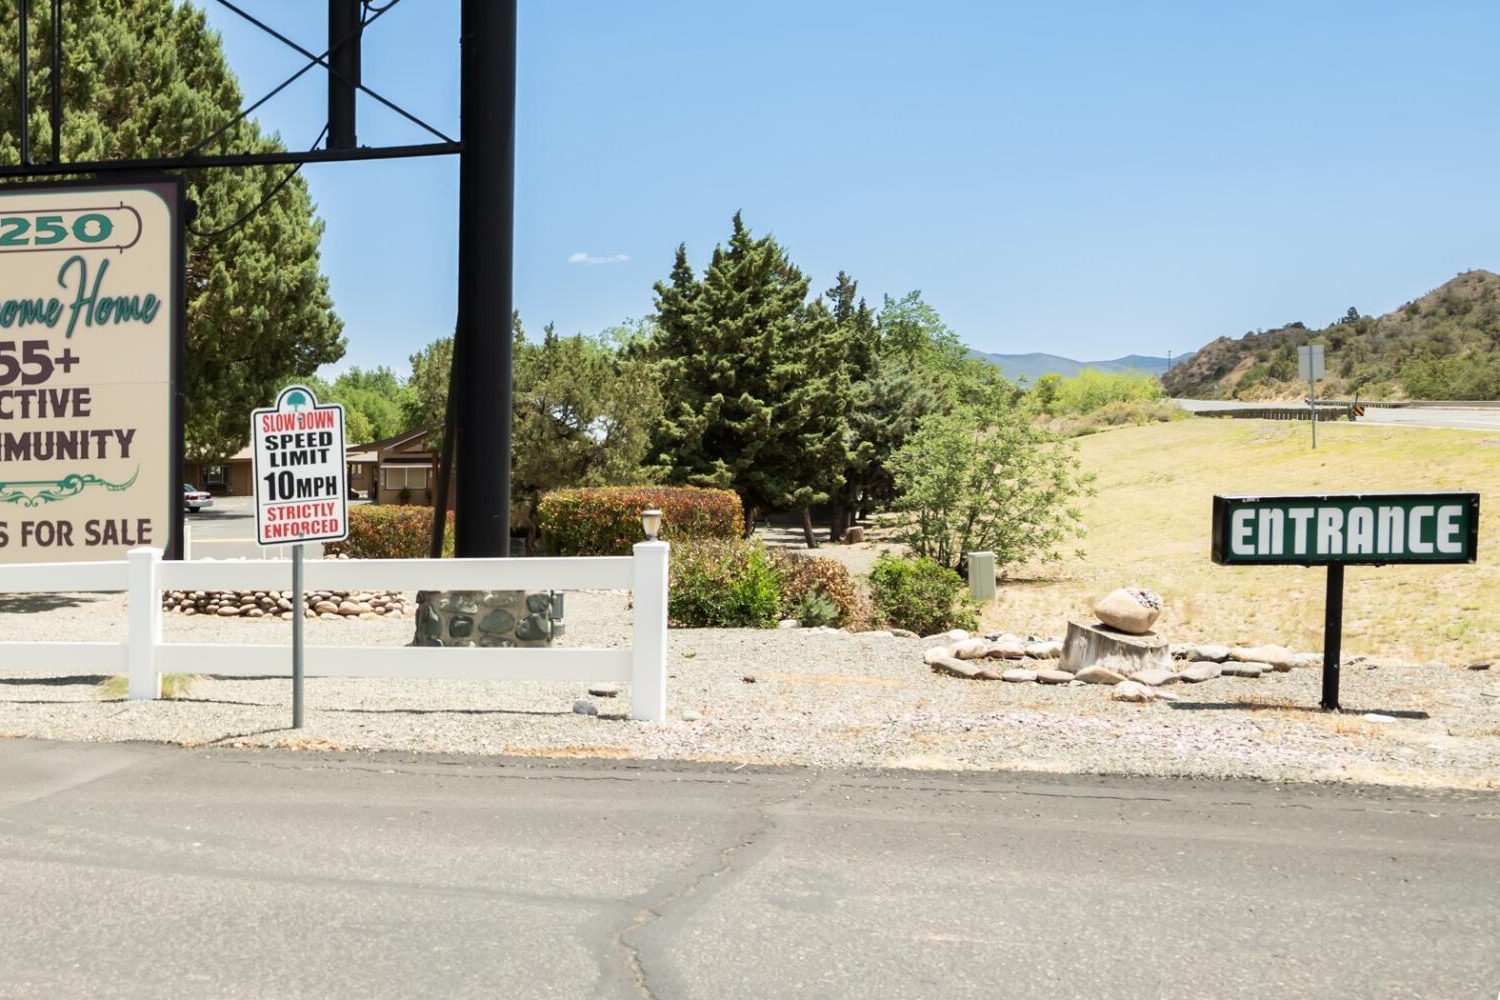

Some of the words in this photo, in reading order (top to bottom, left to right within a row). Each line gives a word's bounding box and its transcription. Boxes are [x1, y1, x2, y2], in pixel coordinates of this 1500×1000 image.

[57, 255, 161, 339] Home
[262, 413, 296, 433] SLOW
[299, 411, 335, 431] DOWN
[265, 431, 333, 451] SPEED
[269, 448, 330, 468] LIMIT
[267, 502, 335, 522] STRICTLY
[21, 520, 74, 548] FOR
[84, 518, 152, 547] SALE
[264, 518, 339, 539] ENFORCED
[1231, 505, 1463, 555] ENTRANCE
